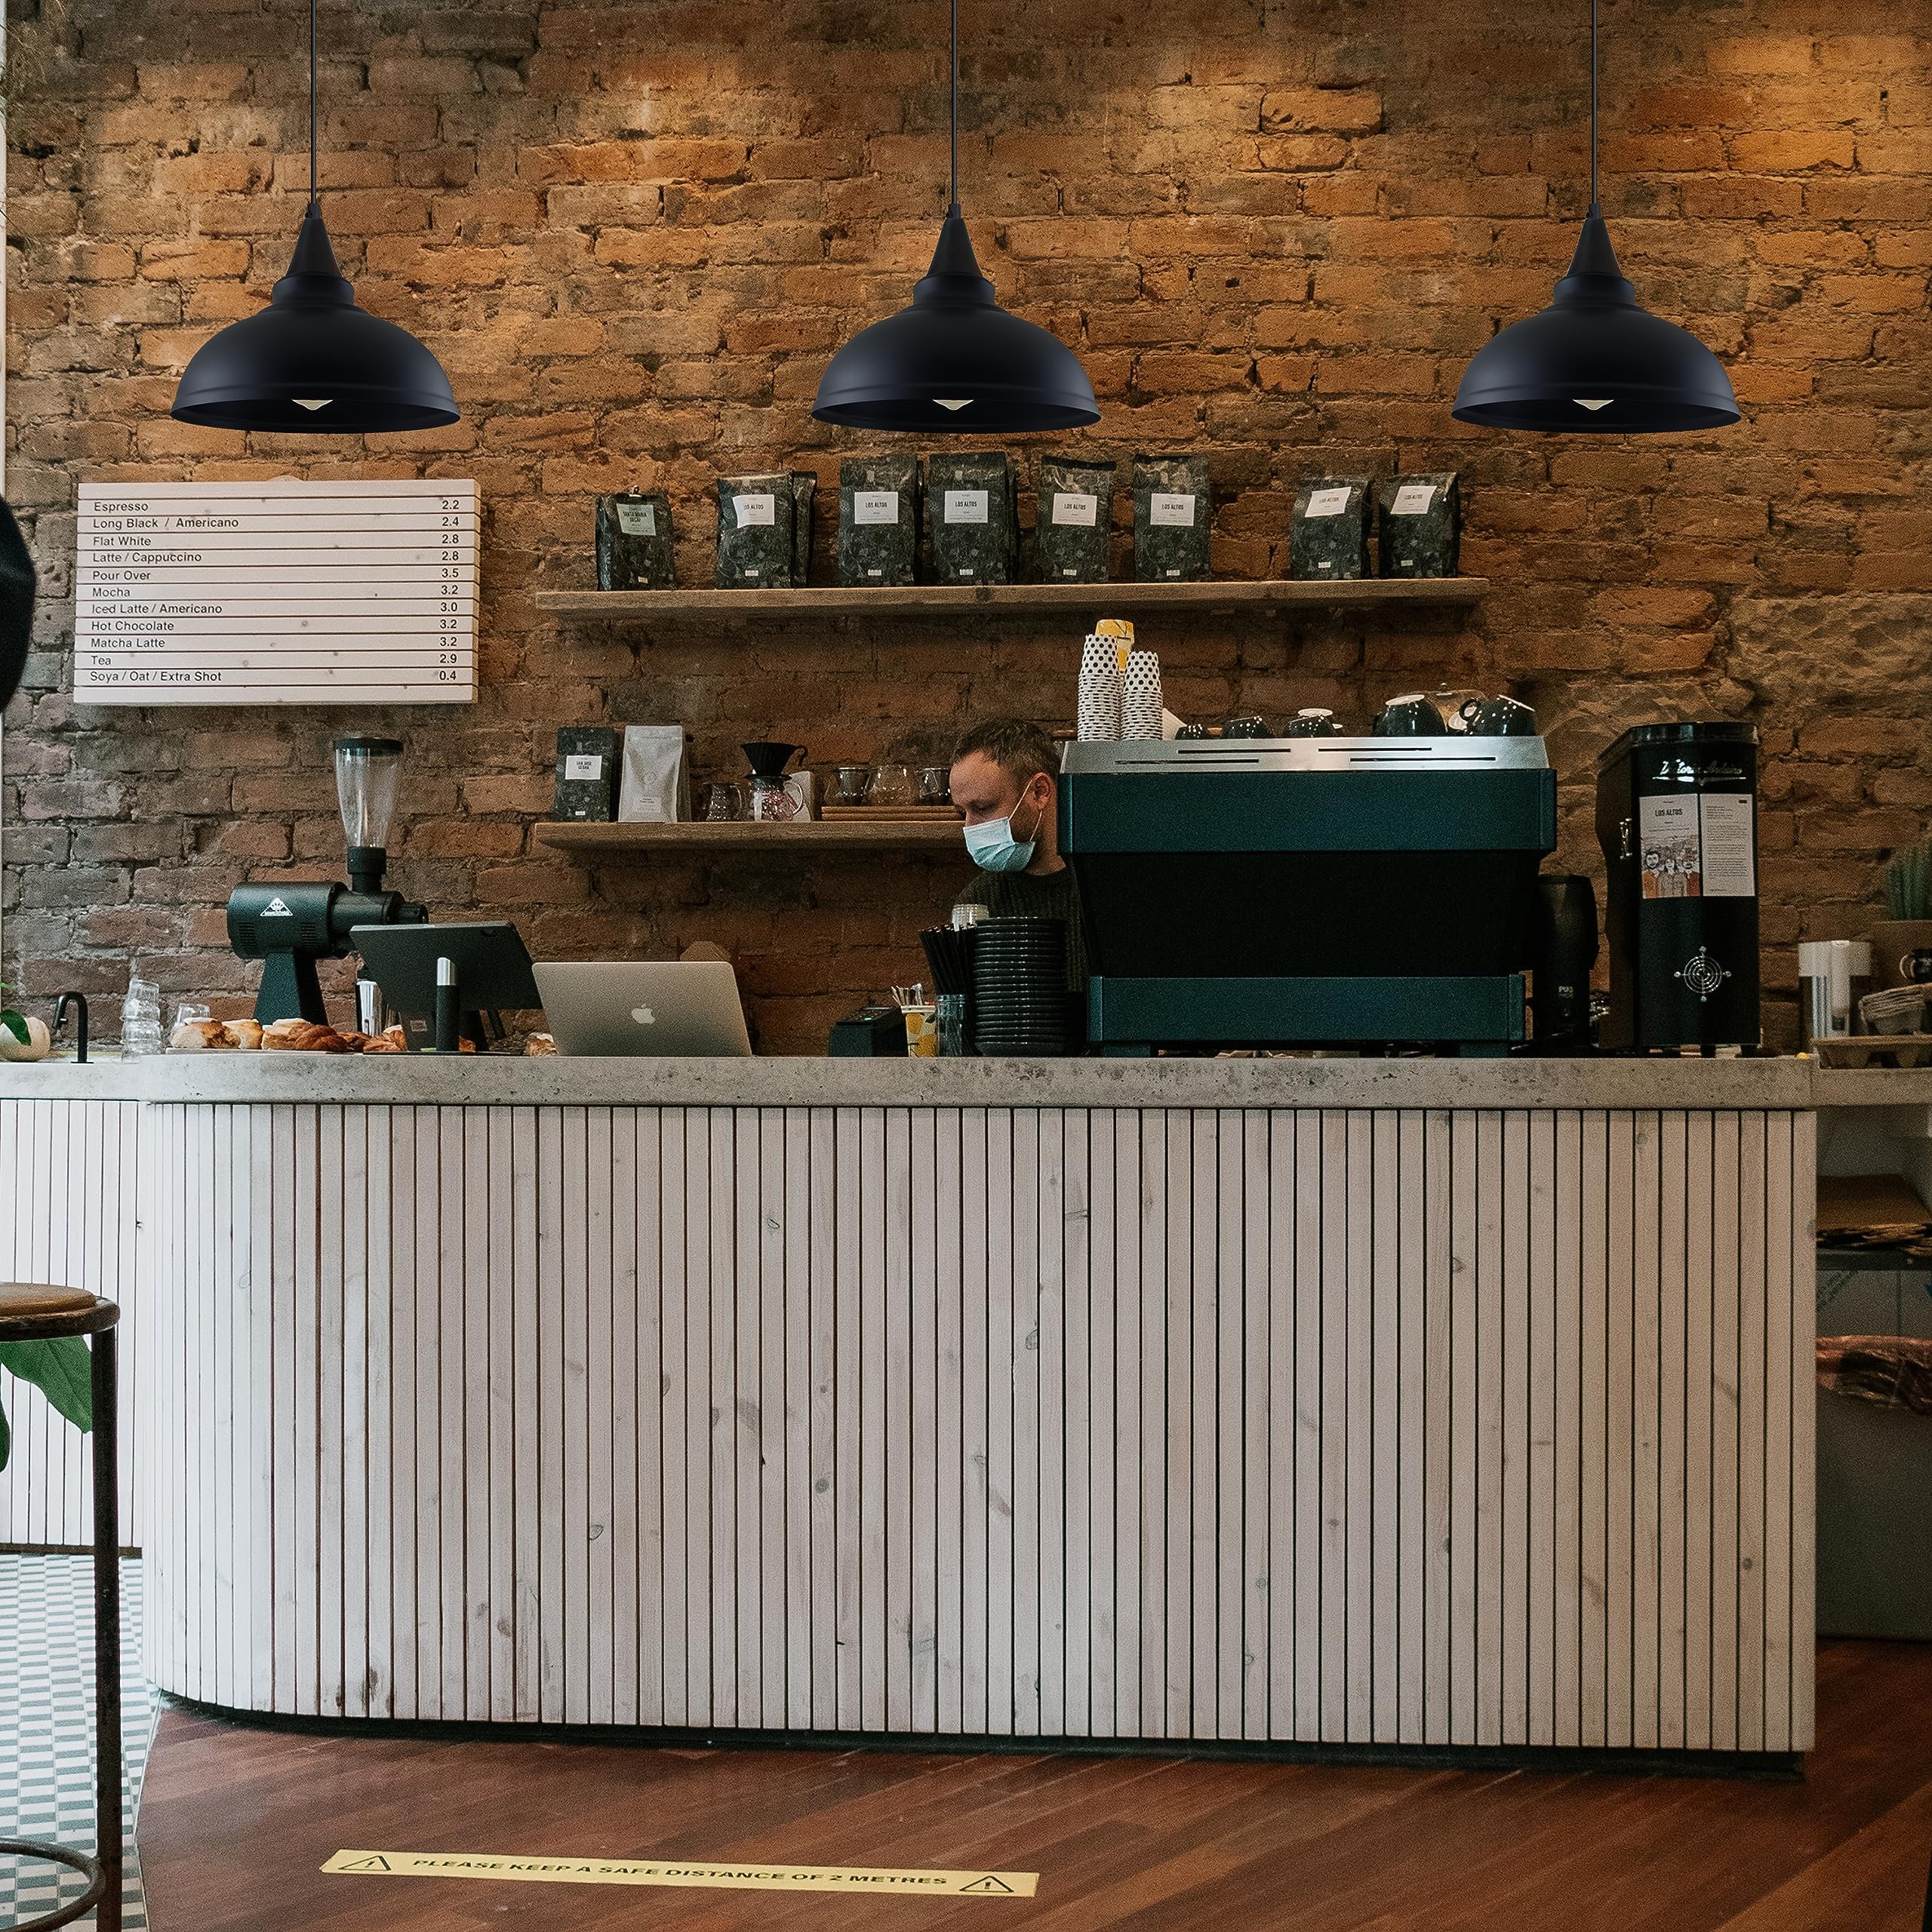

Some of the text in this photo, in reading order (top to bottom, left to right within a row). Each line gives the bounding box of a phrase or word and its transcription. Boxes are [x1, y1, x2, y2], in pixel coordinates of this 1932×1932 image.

[94, 500, 459, 512] Espresso 2.2
[94, 519, 122, 530] Long
[127, 518, 158, 528] Black
[176, 517, 238, 528] Americano
[442, 517, 459, 526] 2.4
[94, 534, 459, 546] Flat White 2.8
[93, 552, 122, 562] Latte
[132, 552, 202, 564] Cappuccino
[442, 551, 459, 561] 2.8
[93, 568, 459, 580] Pour Over 3.5
[93, 585, 458, 597] Mocha 3.2
[92, 604, 115, 614] Iced
[121, 604, 149, 614] Latte
[159, 604, 222, 614] Americano
[441, 602, 457, 611] 3.0
[92, 619, 457, 631] Hot Chocolate 3.2
[91, 637, 457, 648] Matcha Latte 3.2
[91, 654, 457, 665] Tea 2.9
[91, 672, 118, 684] Soya
[130, 671, 149, 681] Oat
[161, 672, 190, 681] Extra
[193, 671, 223, 681] Shot
[439, 670, 457, 680] 0.4
[413, 1860, 503, 1869] PLEASE
[598, 1866, 660, 1875] SAFE
[666, 1869, 786, 1880] DISTANCE
[849, 1875, 948, 1884] METRES
